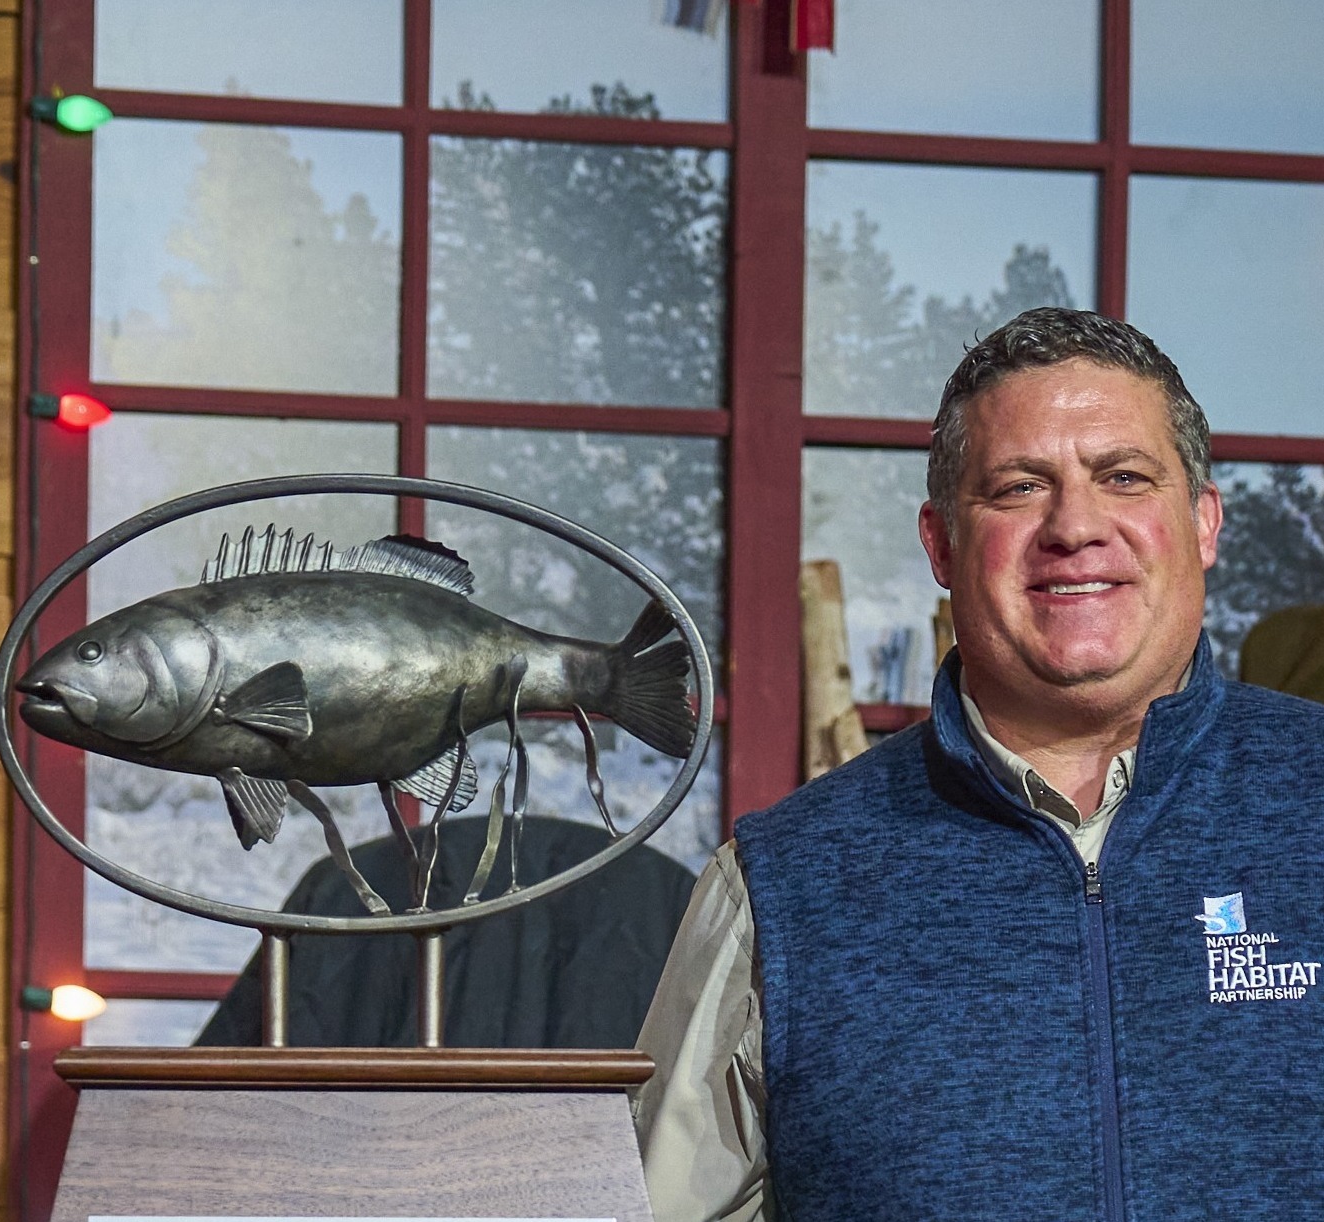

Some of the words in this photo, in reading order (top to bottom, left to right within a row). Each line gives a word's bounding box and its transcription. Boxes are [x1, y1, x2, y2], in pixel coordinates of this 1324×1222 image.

[1206, 932, 1279, 949] NATIONAL
[1207, 945, 1267, 969] FISH
[1209, 961, 1321, 991] HABITAT
[1210, 986, 1307, 1003] PARTNERSHIP
